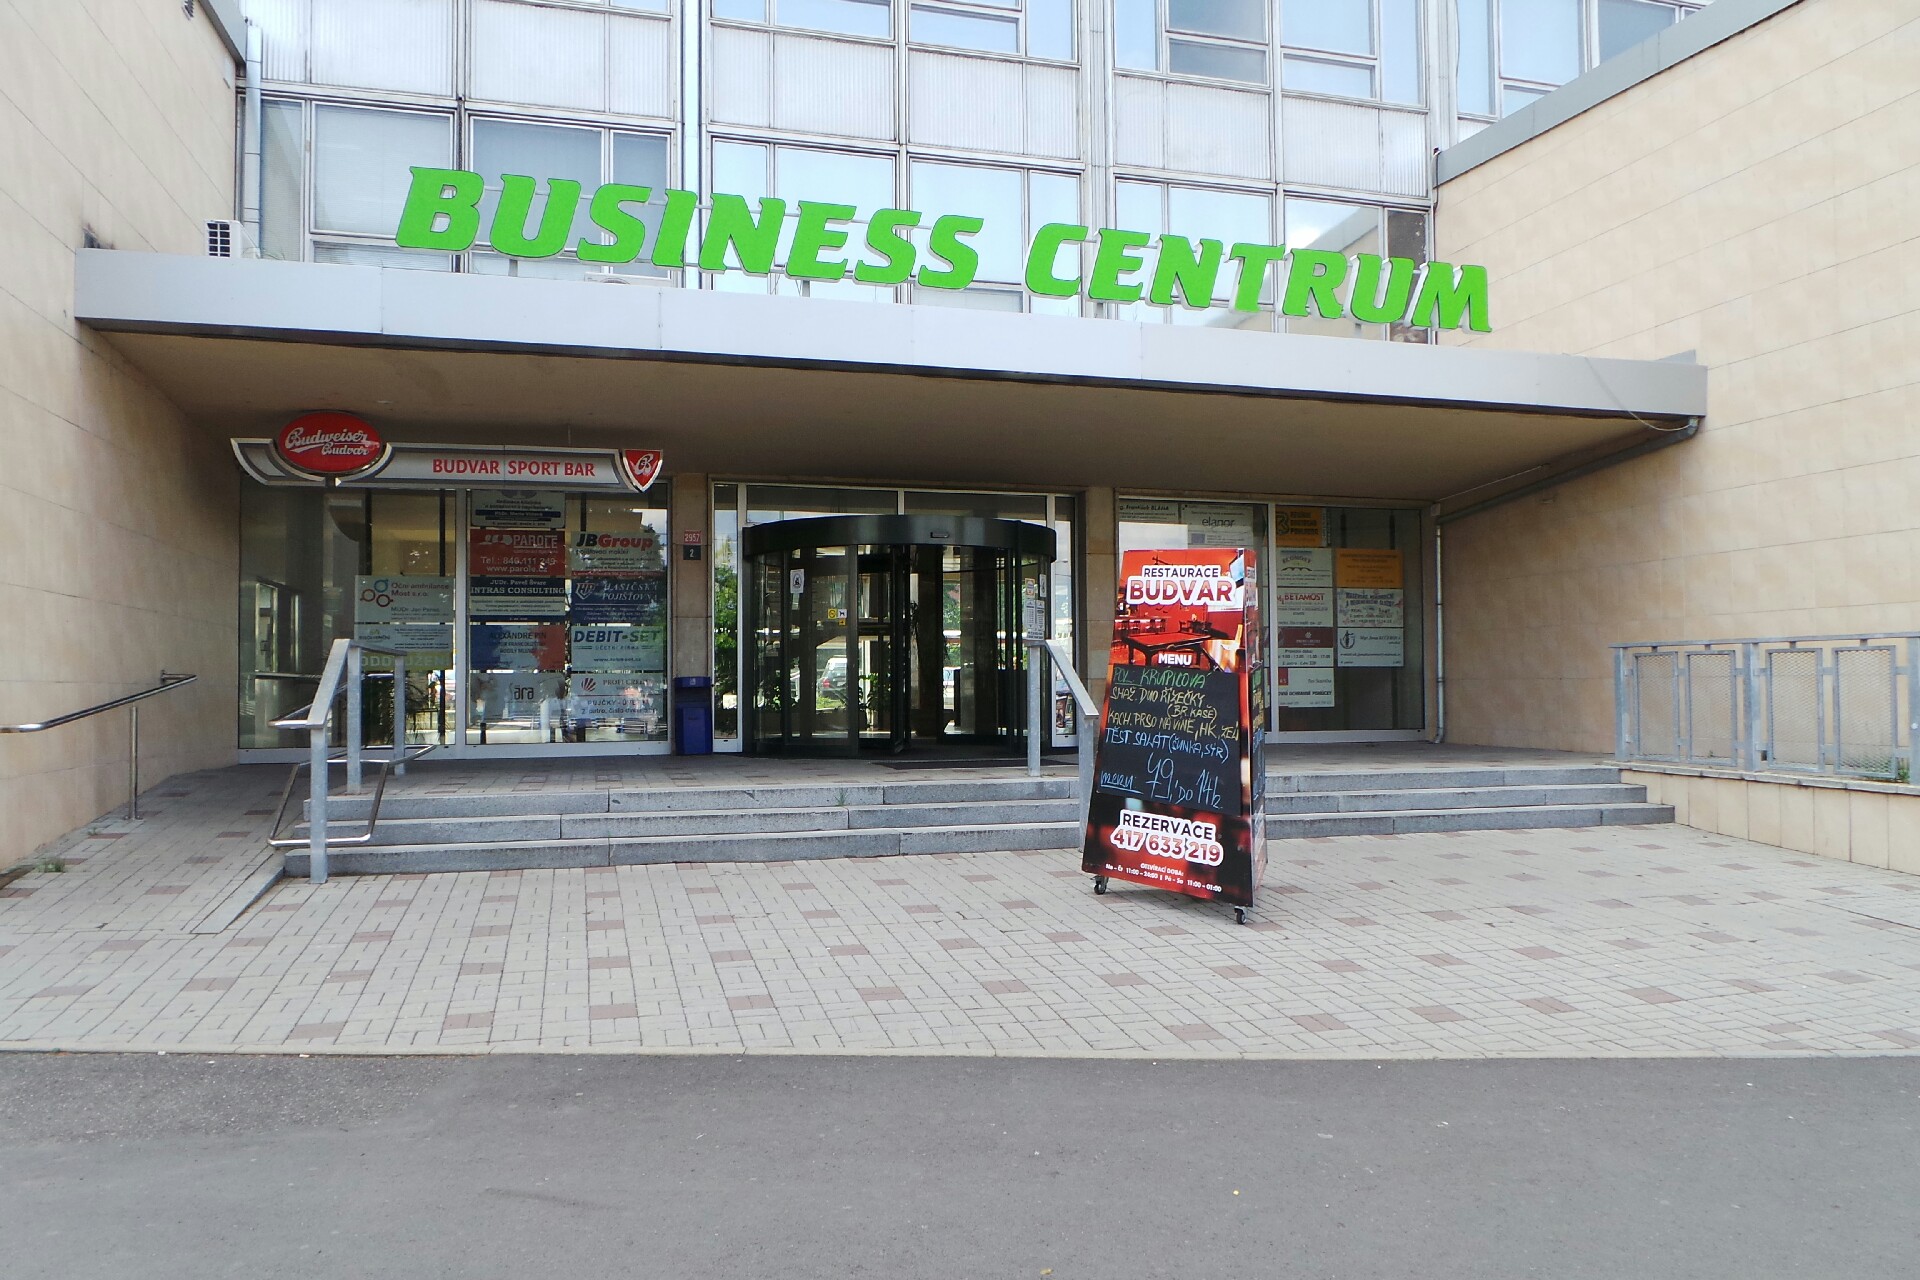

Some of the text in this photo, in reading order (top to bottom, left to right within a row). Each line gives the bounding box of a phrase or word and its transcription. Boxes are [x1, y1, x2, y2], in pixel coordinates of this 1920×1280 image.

[395, 166, 1493, 333] BUSINESS CENTRUM
[285, 427, 369, 450] Budweiser
[321, 444, 370, 456] Budvar
[432, 458, 595, 477] BUDVAR SPORT BAR
[1201, 516, 1235, 527] elanor
[513, 534, 558, 549] PAROLE
[575, 533, 654, 552] JBGroup
[684, 533, 700, 542] 2957
[689, 549, 694, 558] 2
[1143, 567, 1219, 578] RESTAURACE
[470, 586, 505, 594] INTRAS
[1129, 579, 1233, 601] BUDVAR
[1158, 653, 1192, 666] MENU
[1122, 812, 1214, 841] REZERVACE
[1113, 828, 1221, 863] 417 633 219
